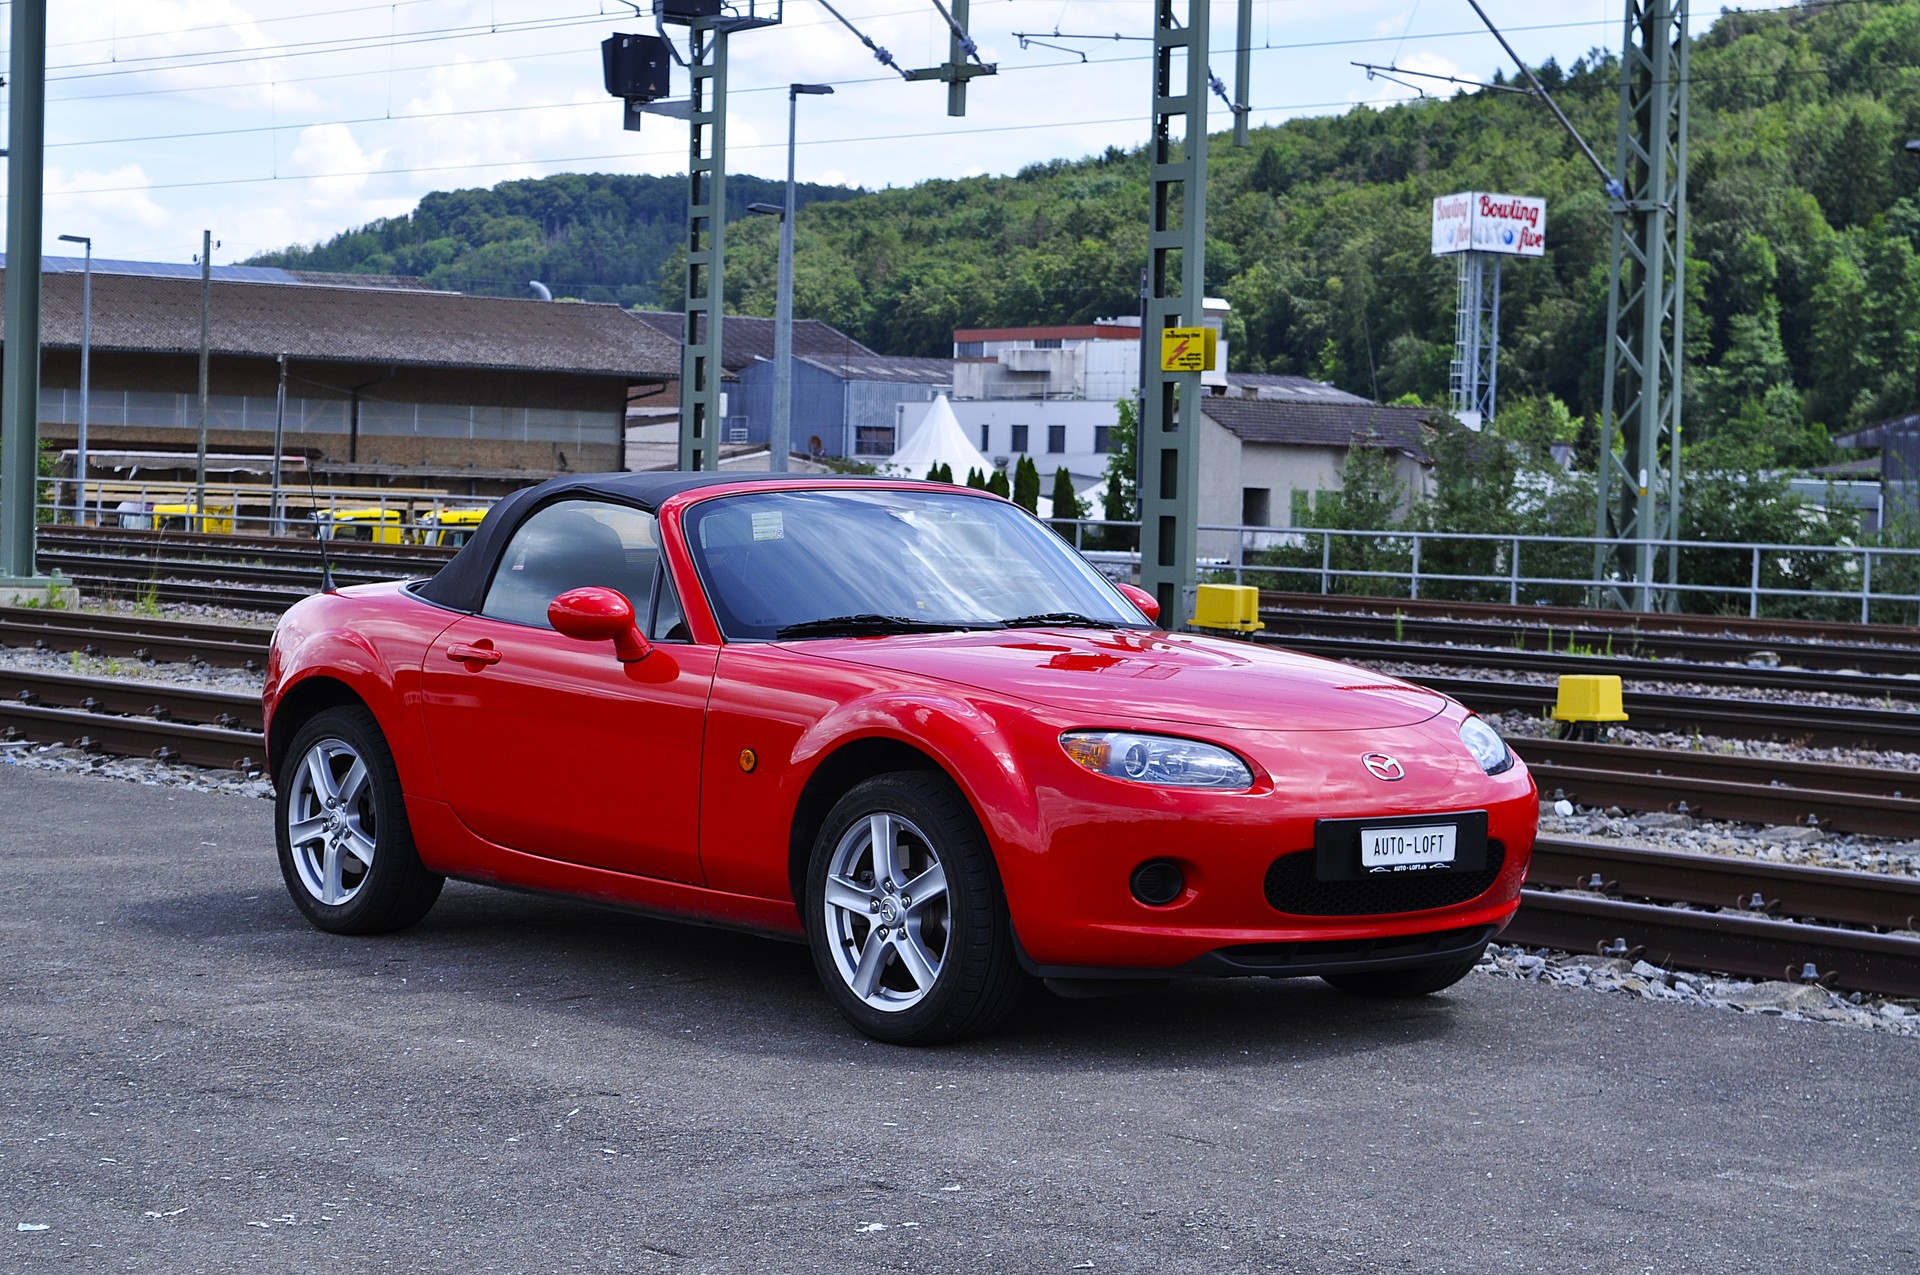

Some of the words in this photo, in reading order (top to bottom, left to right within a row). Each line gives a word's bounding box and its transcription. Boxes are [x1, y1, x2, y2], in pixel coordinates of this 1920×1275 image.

[1437, 199, 1467, 222] Bowling
[1479, 195, 1539, 228] Bowling
[1518, 226, 1543, 252] five
[1373, 834, 1444, 856] AUTO-LOFT
